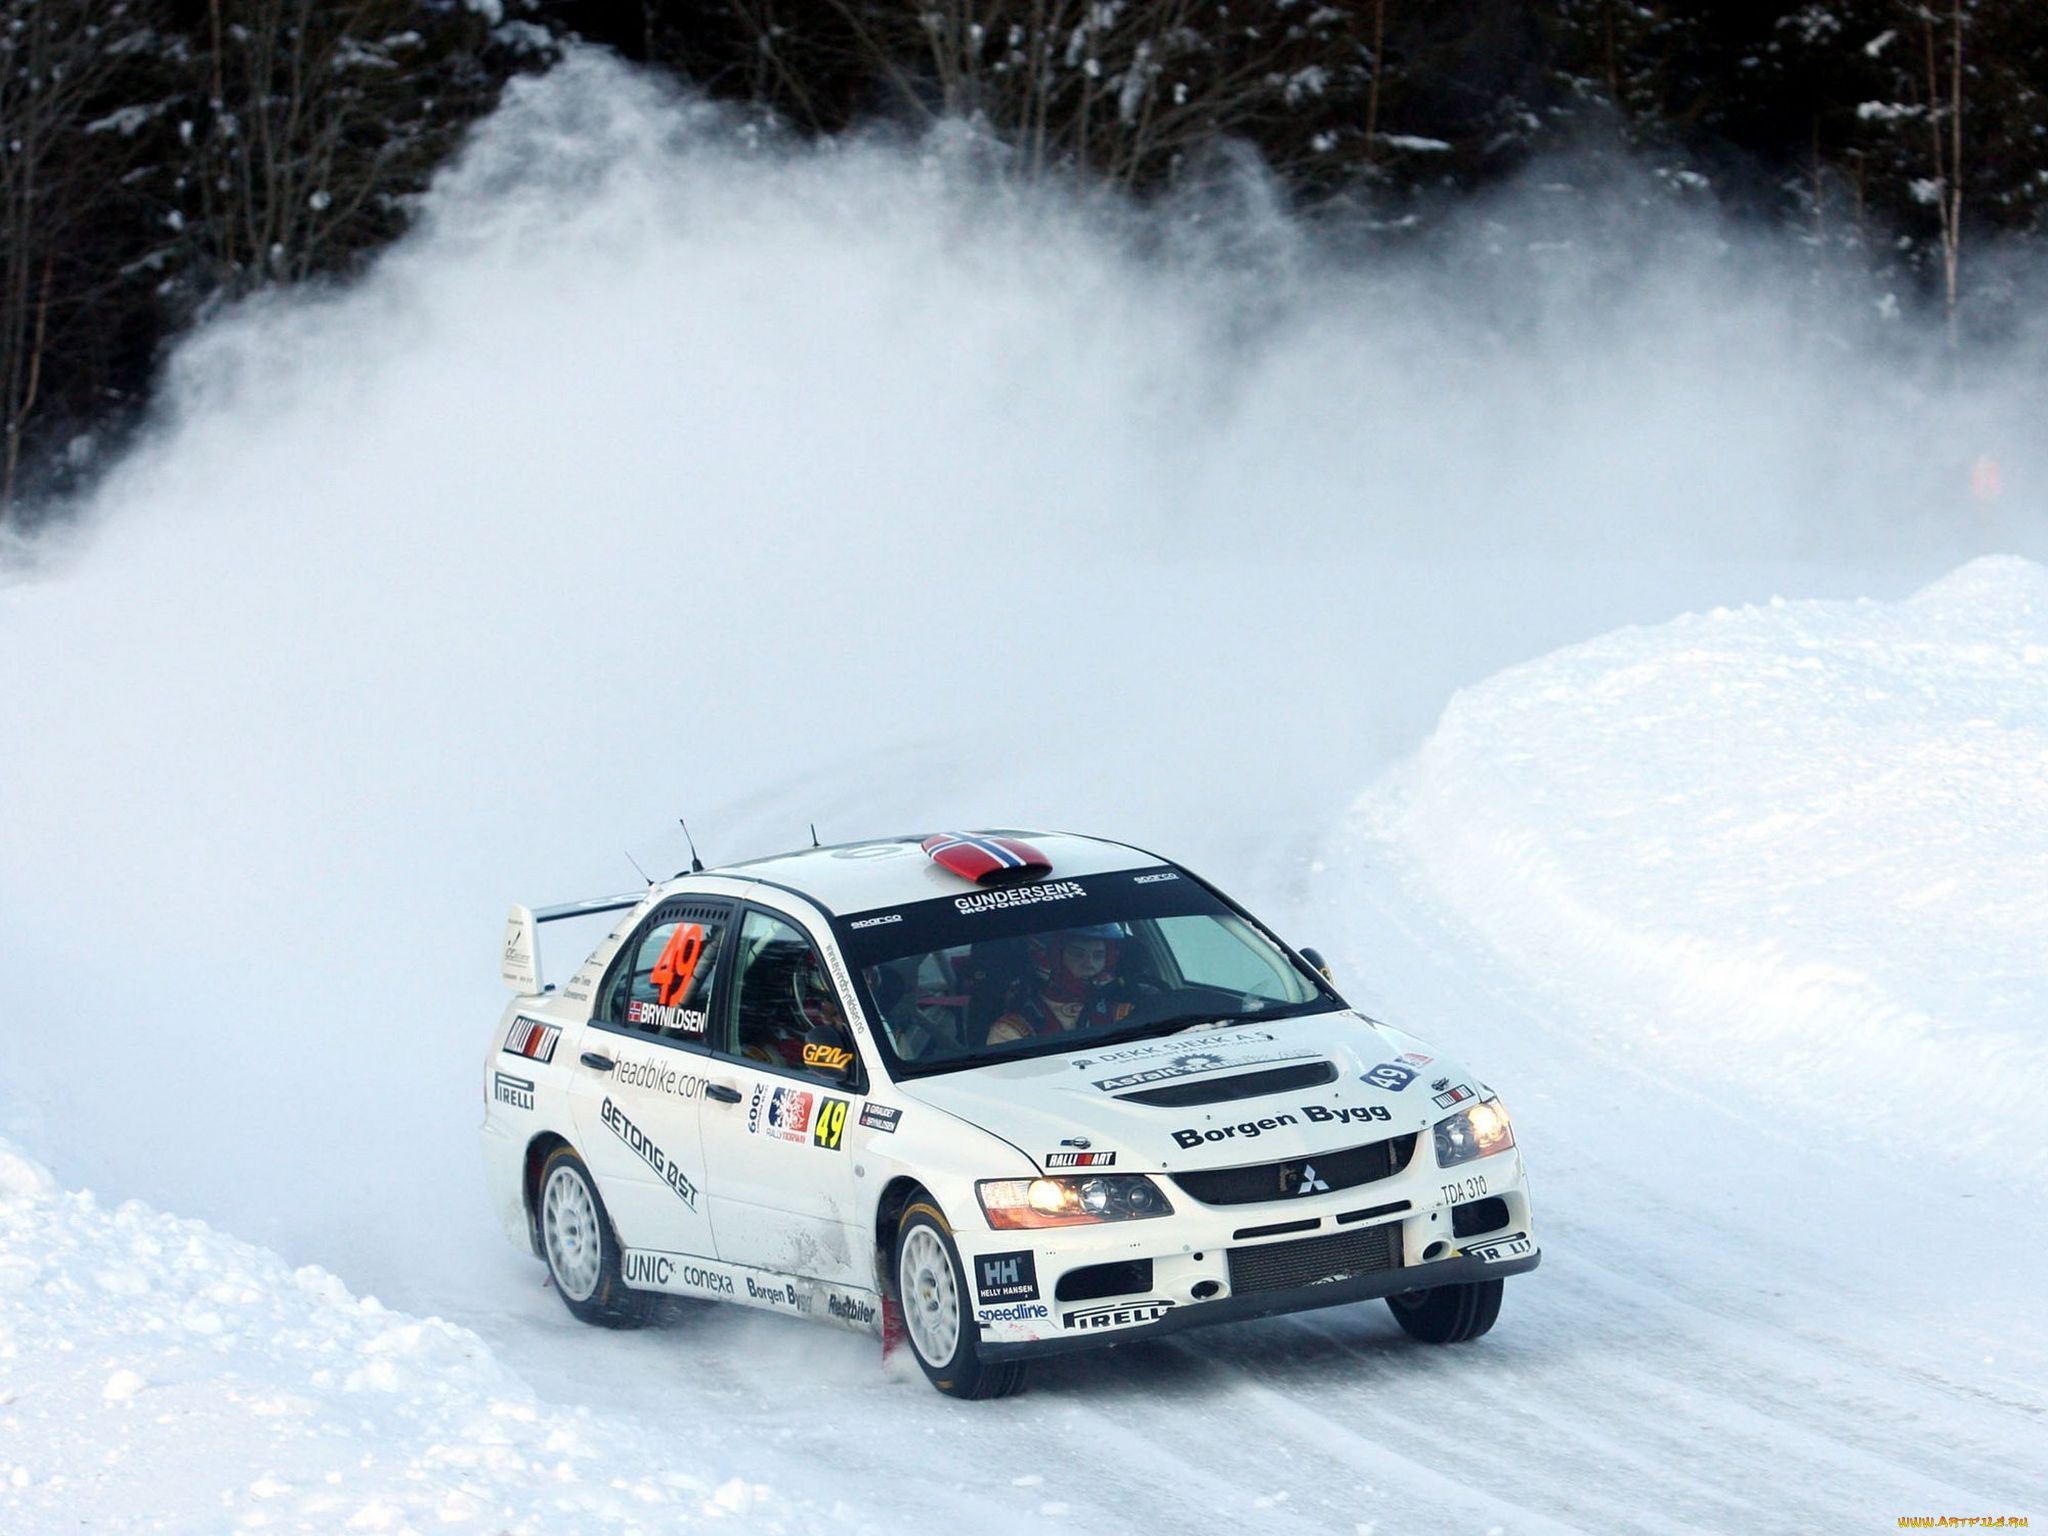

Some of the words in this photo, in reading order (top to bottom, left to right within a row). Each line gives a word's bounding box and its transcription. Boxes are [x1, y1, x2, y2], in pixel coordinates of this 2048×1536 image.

[954, 882, 1069, 909] GUNDERSEN
[960, 892, 1077, 915] MOTORSPORT
[850, 914, 903, 930] sparco
[650, 922, 703, 1008] 49
[640, 1003, 706, 1033] BRYNILDSEN
[803, 1043, 853, 1069] GPM
[1099, 1046, 1160, 1062] DEKK
[611, 1050, 710, 1101] headbike.com
[1103, 1066, 1183, 1089] Asfalt
[1369, 1068, 1408, 1088] 49
[495, 1071, 534, 1111] PIRELLI
[747, 1082, 764, 1134] 2009
[815, 1100, 847, 1148] 49
[1171, 1114, 1298, 1149] Borgen
[1301, 1105, 1392, 1123] Bygg
[601, 1096, 665, 1173] BETONG
[667, 1160, 700, 1206] ØST
[1441, 1183, 1466, 1205] TDA
[1466, 1175, 1488, 1199] 310
[626, 1254, 669, 1285] UNIC
[684, 1265, 735, 1294] conexa
[984, 1259, 1019, 1286] HH
[746, 1277, 786, 1304] Borgen
[980, 1287, 1001, 1298] HELLY
[1003, 1284, 1033, 1296] HANSEN
[978, 1303, 1049, 1322] speedline
